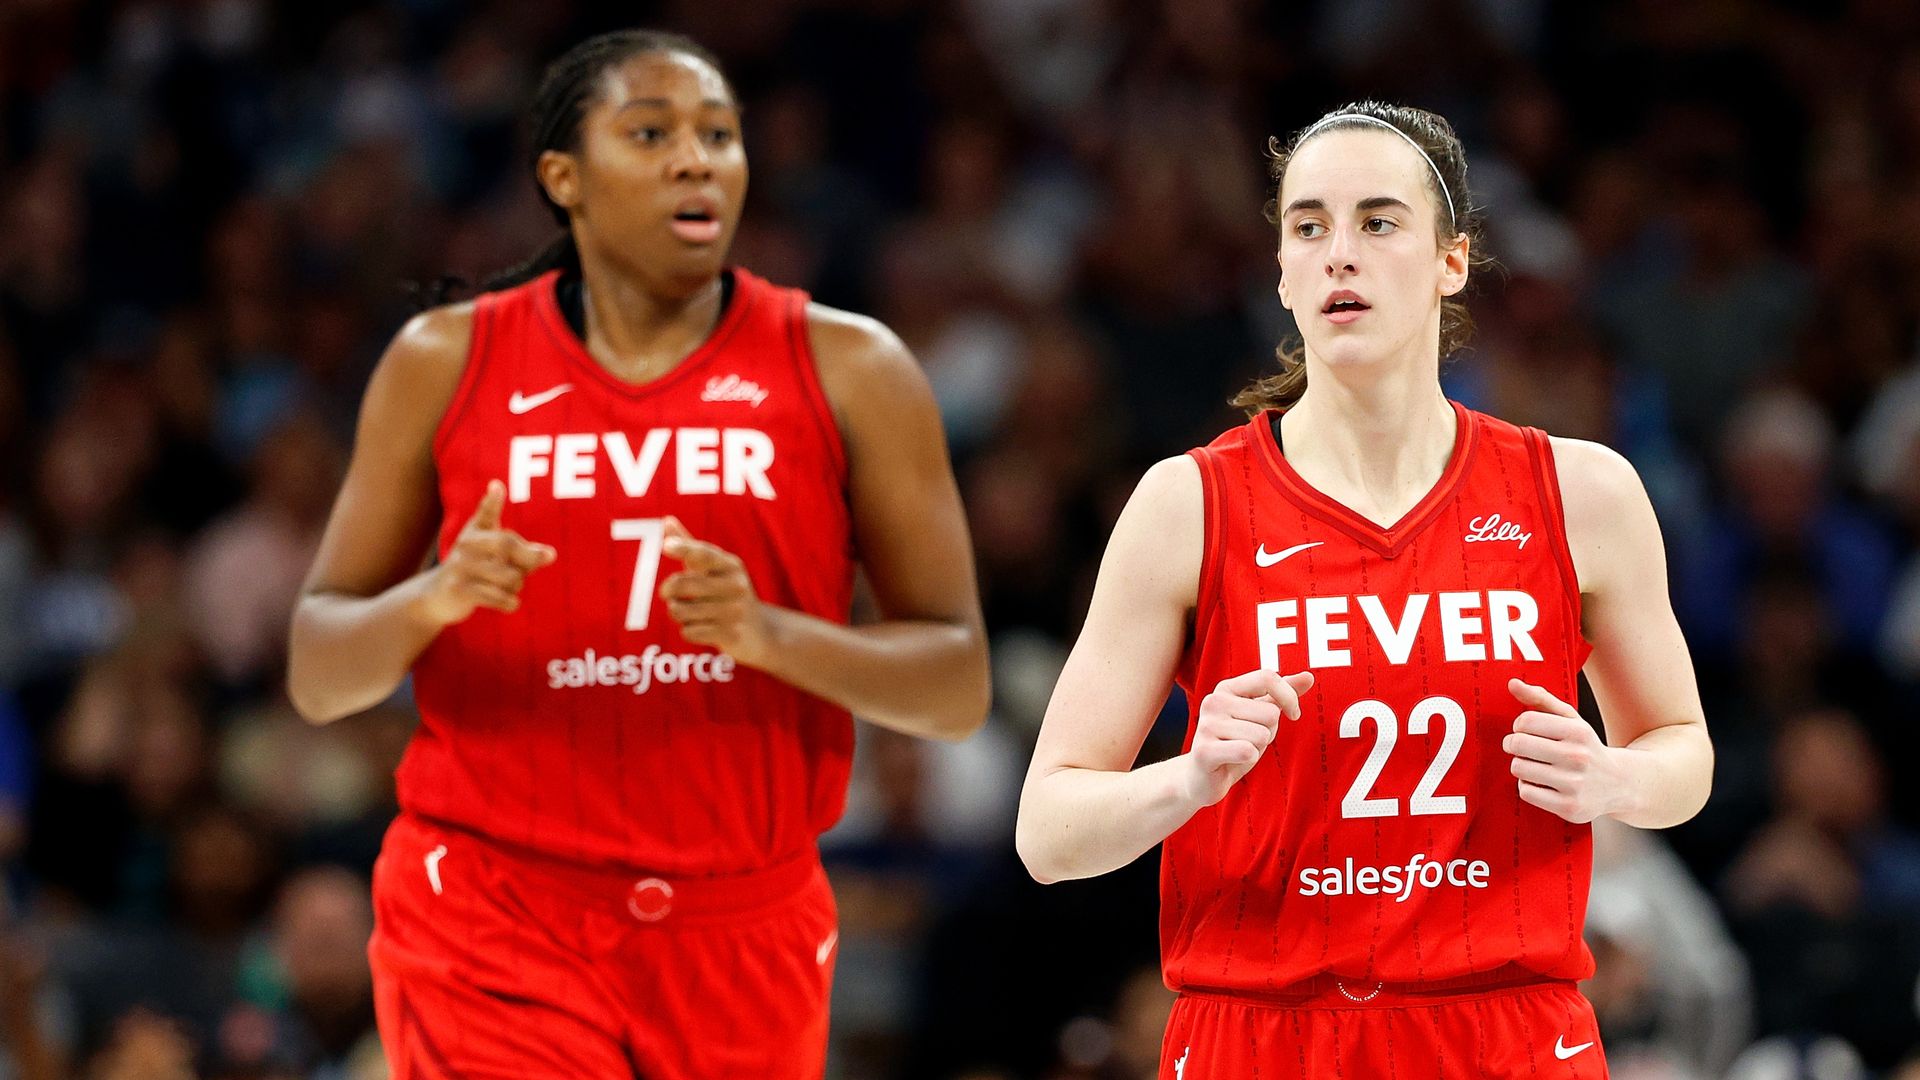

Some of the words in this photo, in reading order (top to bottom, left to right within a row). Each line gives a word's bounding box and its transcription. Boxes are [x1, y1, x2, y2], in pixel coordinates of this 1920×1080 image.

[508, 427, 778, 504] FEVER
[1464, 512, 1533, 551] Lilly
[610, 517, 666, 632] 7
[546, 643, 736, 696] salesforce
[1256, 589, 1545, 674] FEVER
[1338, 696, 1468, 820] 22
[1298, 853, 1491, 903] salesfoce
